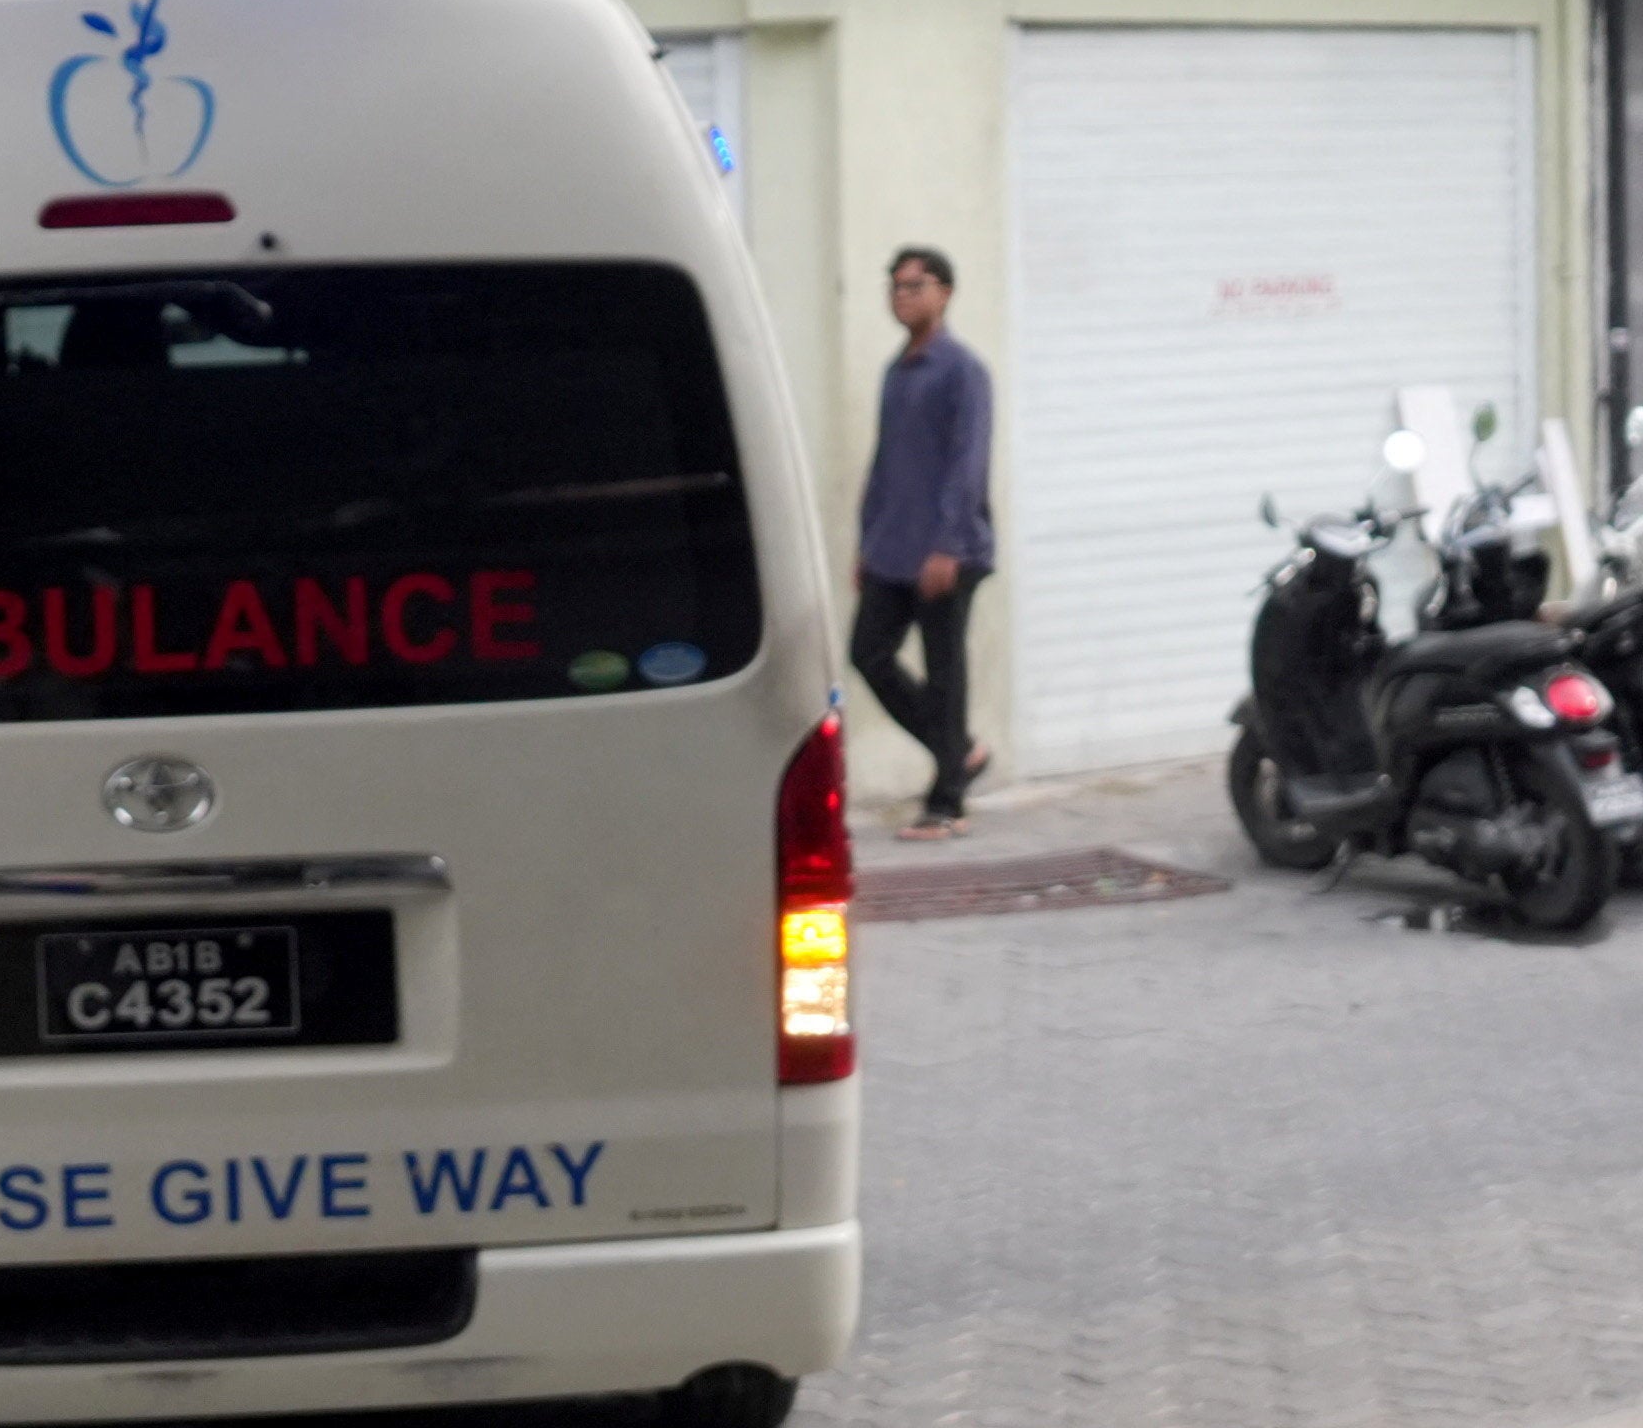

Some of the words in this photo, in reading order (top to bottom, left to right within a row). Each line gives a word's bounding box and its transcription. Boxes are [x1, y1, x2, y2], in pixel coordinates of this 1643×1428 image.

[68, 976, 272, 1030] C4352
[150, 1154, 368, 1225] GIVE
[404, 1142, 603, 1214] WAY
